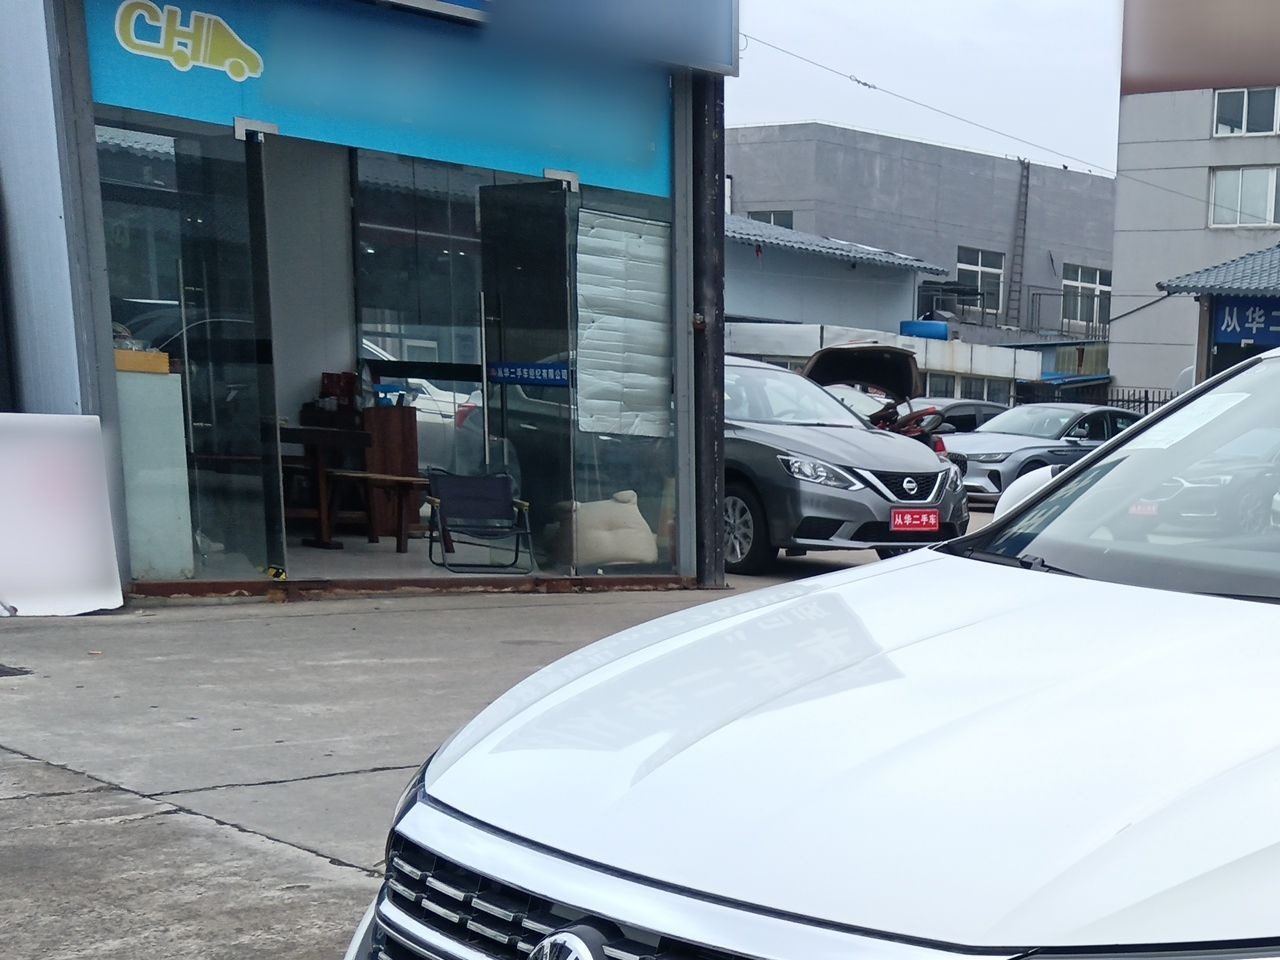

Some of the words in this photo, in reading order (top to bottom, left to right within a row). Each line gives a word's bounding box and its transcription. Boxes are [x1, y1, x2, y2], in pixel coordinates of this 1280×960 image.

[894, 513, 937, 526] 从华二手车
